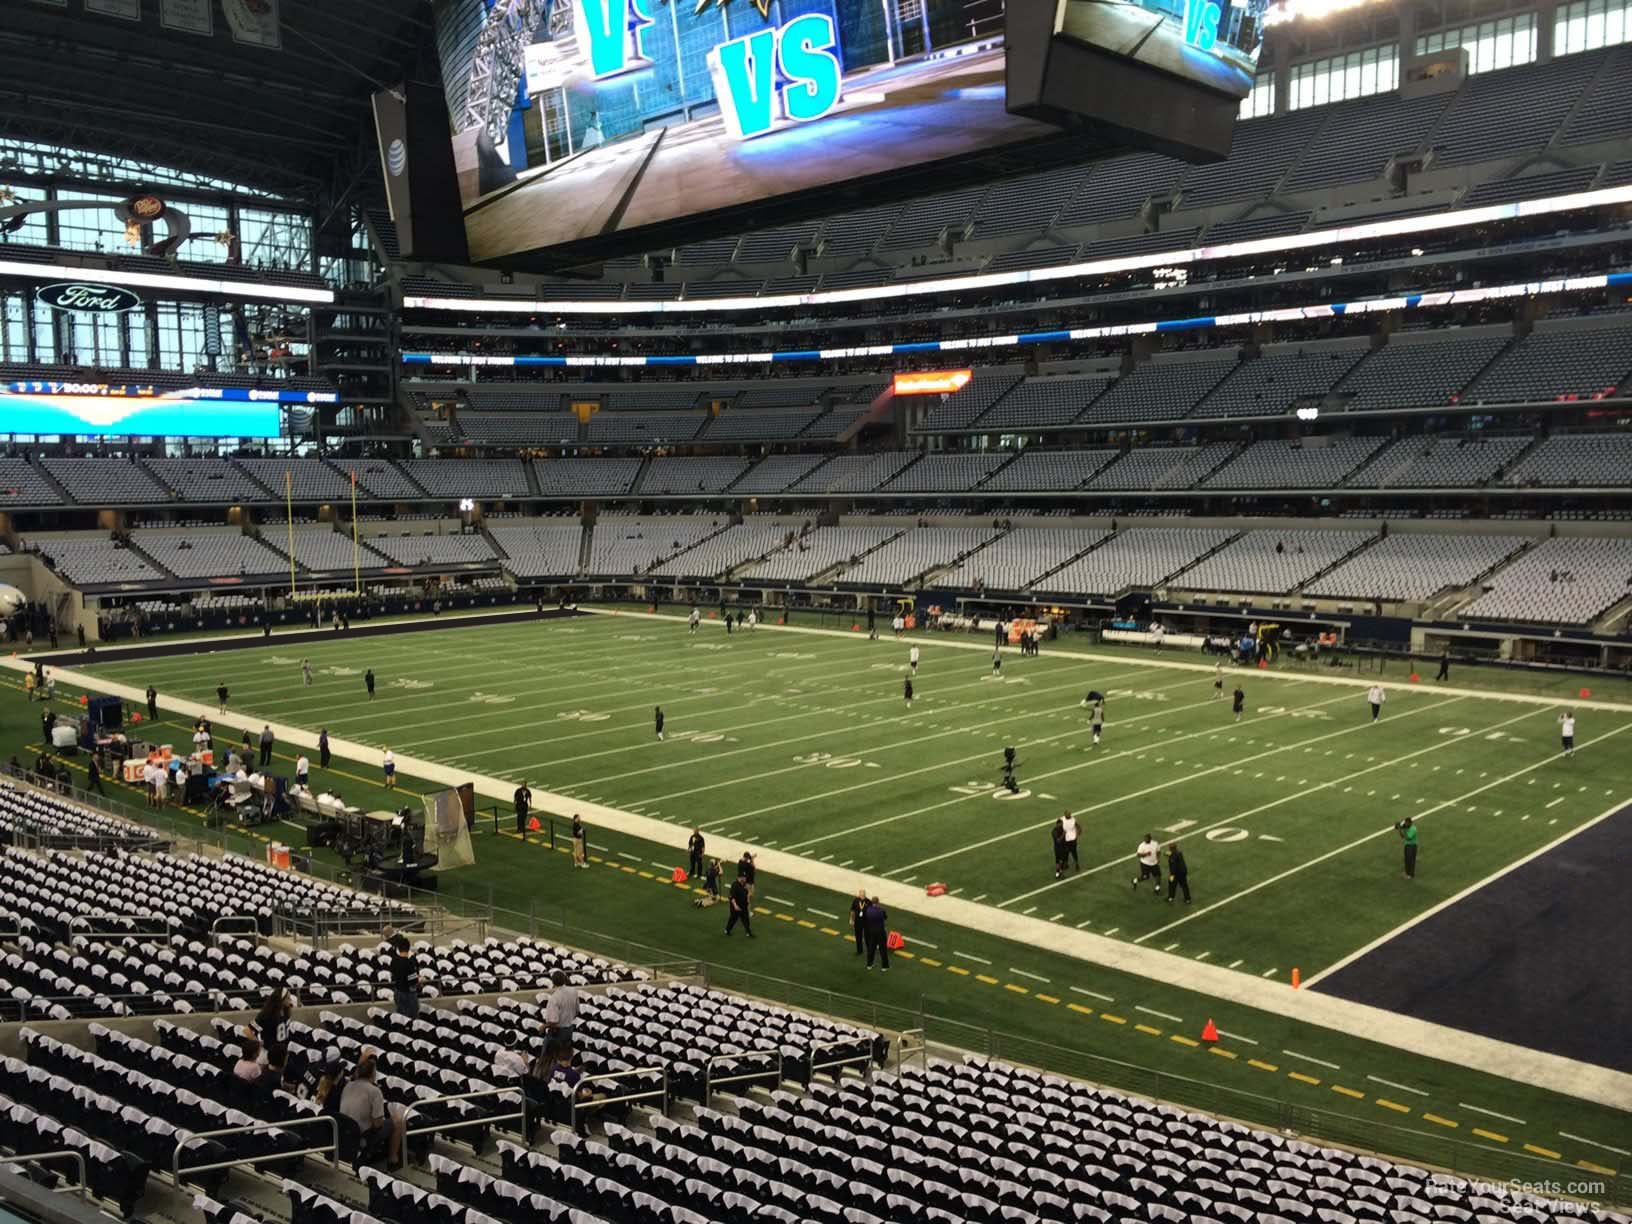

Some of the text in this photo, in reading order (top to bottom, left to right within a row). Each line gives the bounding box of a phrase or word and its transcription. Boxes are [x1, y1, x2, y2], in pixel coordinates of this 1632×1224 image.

[1184, 0, 1221, 50] VS
[712, 14, 840, 138] VS
[57, 286, 120, 309] Ford
[1154, 818, 1249, 842] 10
